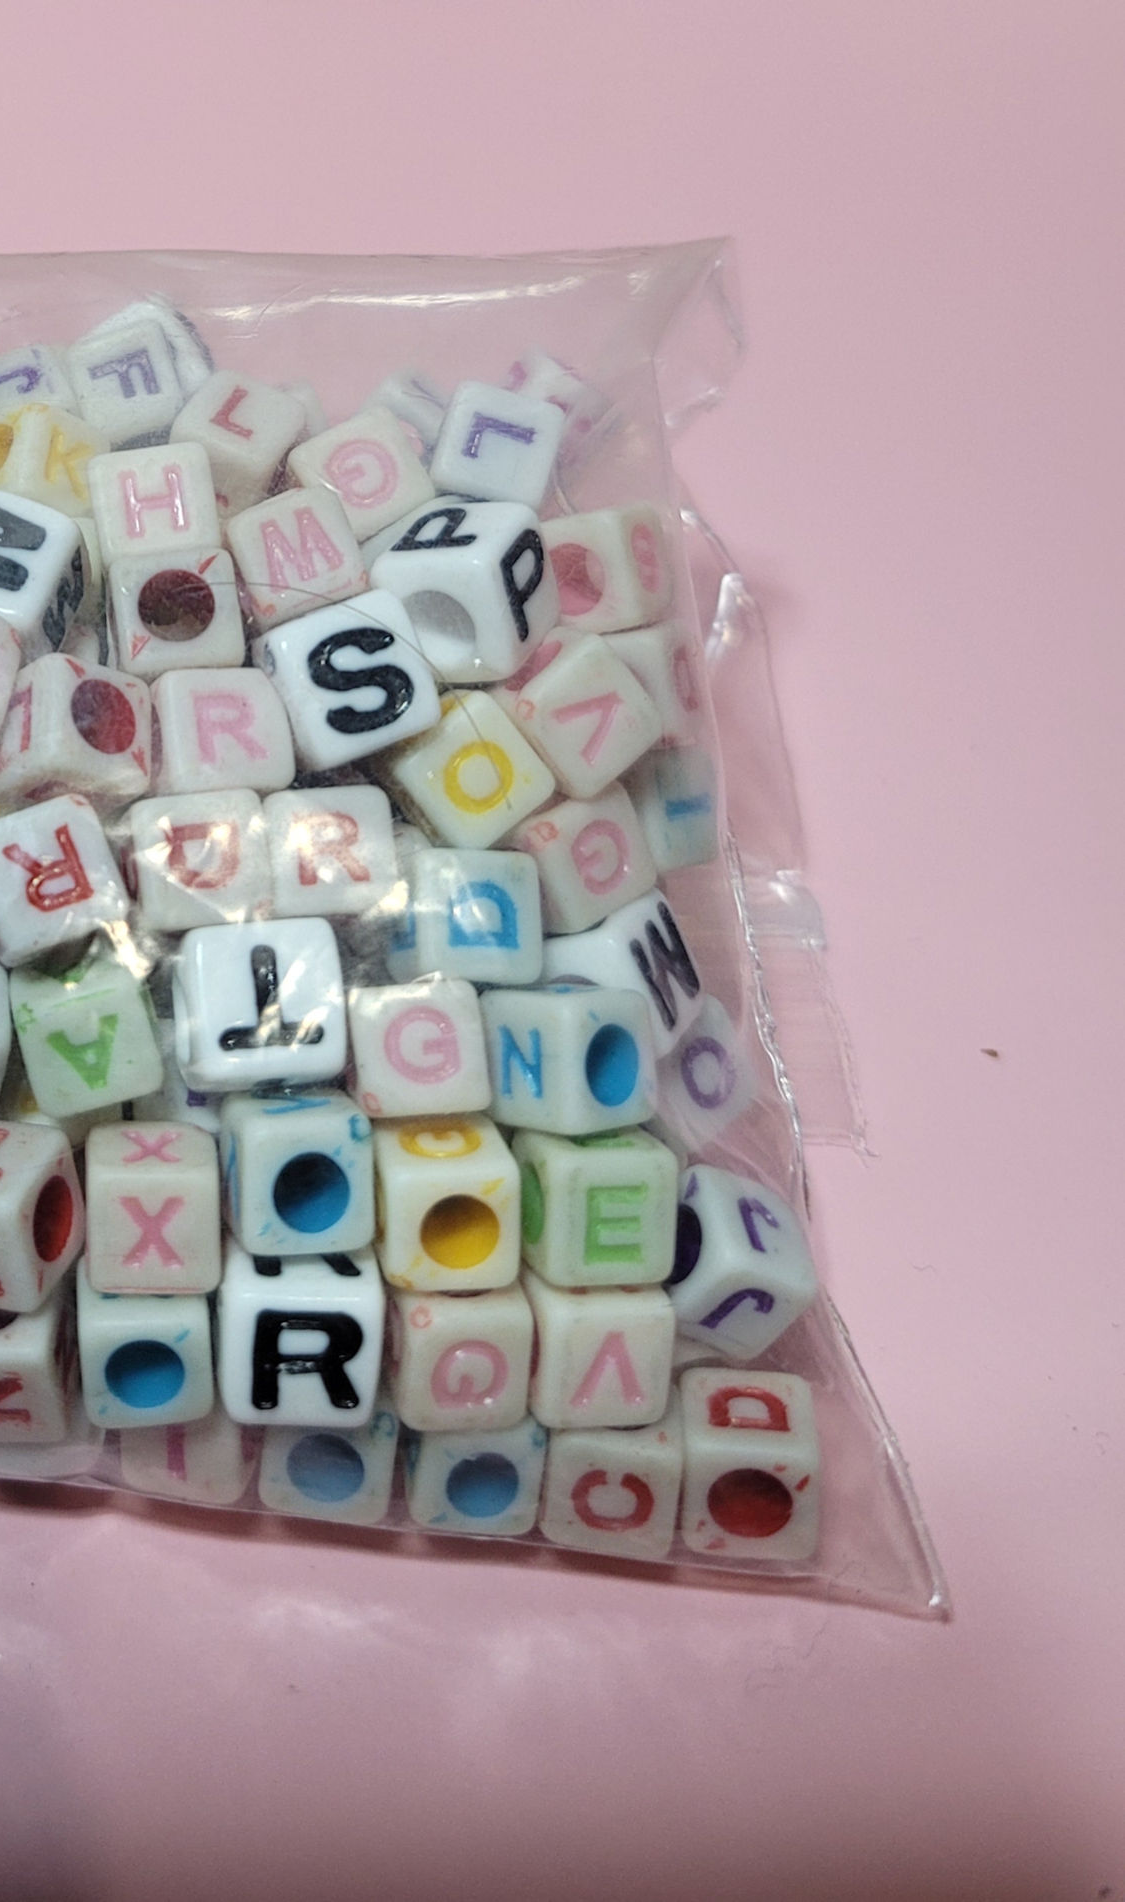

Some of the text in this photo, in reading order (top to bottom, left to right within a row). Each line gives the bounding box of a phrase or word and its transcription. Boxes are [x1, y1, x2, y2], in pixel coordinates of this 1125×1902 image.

[88, 348, 160, 398] F
[209, 385, 253, 440] L
[462, 411, 536, 458] L
[118, 465, 189, 538] H
[323, 440, 398, 508] G
[500, 529, 544, 642] P
[308, 627, 414, 734] S
[192, 690, 269, 764] R
[443, 741, 513, 814] O
[2, 823, 94, 912] R
[290, 811, 370, 886] R
[218, 945, 324, 1052] T
[47, 1013, 119, 1091] A
[384, 1005, 461, 1084] G
[498, 1025, 543, 1099] N
[122, 1131, 180, 1163] X
[118, 1196, 185, 1268] X
[585, 1181, 649, 1265] E
[252, 1308, 364, 1410] R
[707, 1386, 791, 1432] D
[571, 1469, 655, 1531] C
